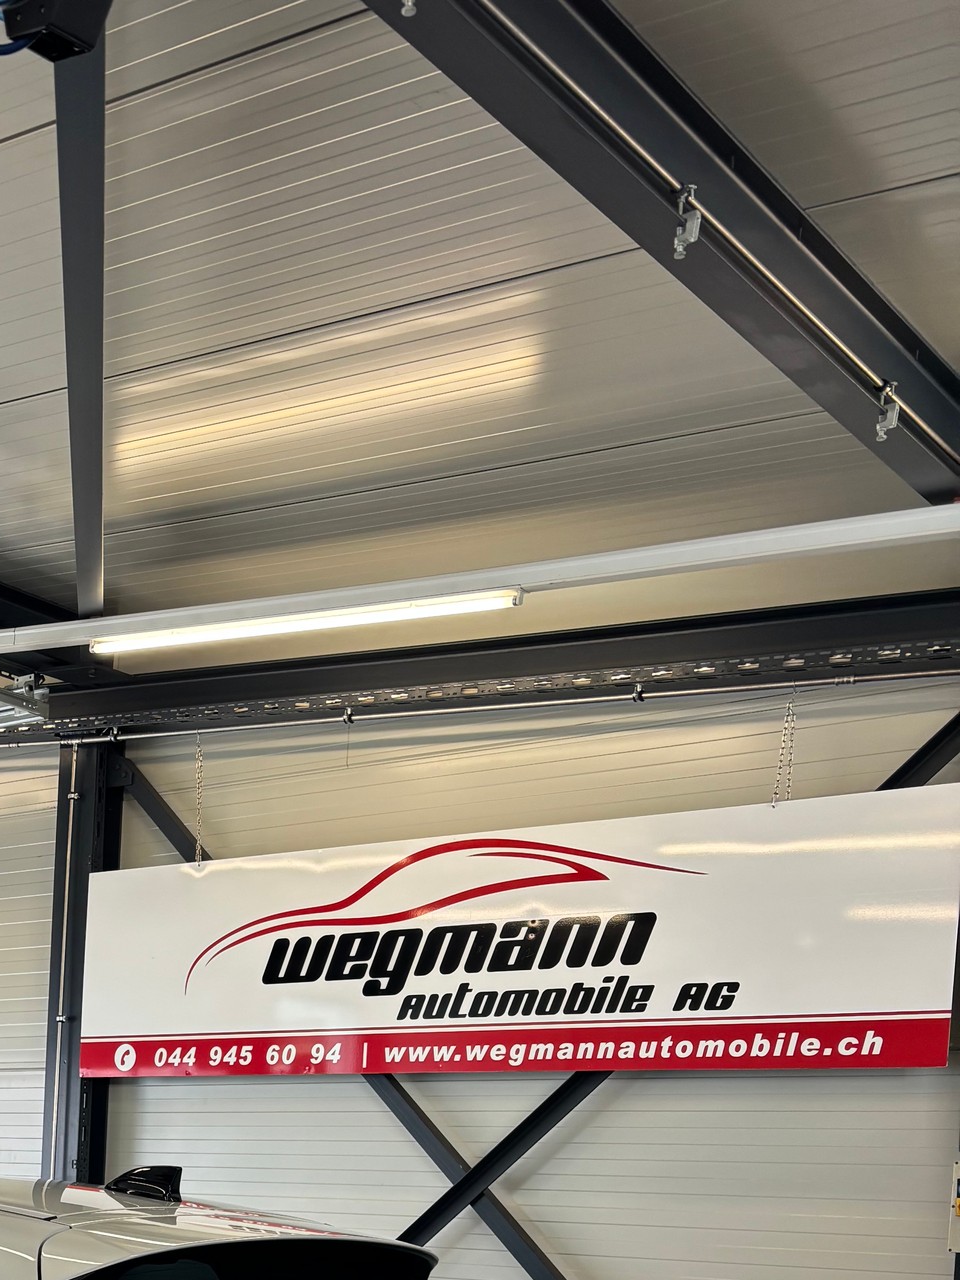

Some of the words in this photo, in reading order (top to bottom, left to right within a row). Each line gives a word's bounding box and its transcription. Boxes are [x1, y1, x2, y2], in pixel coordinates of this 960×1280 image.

[262, 912, 657, 997] wegmann
[673, 982, 740, 1011] AG
[154, 1046, 196, 1068] 044
[209, 1045, 253, 1067] 945
[265, 1044, 296, 1066] 60
[310, 1043, 341, 1064] 94
[384, 1030, 884, 1067] www.wegmannautomobile.ch
